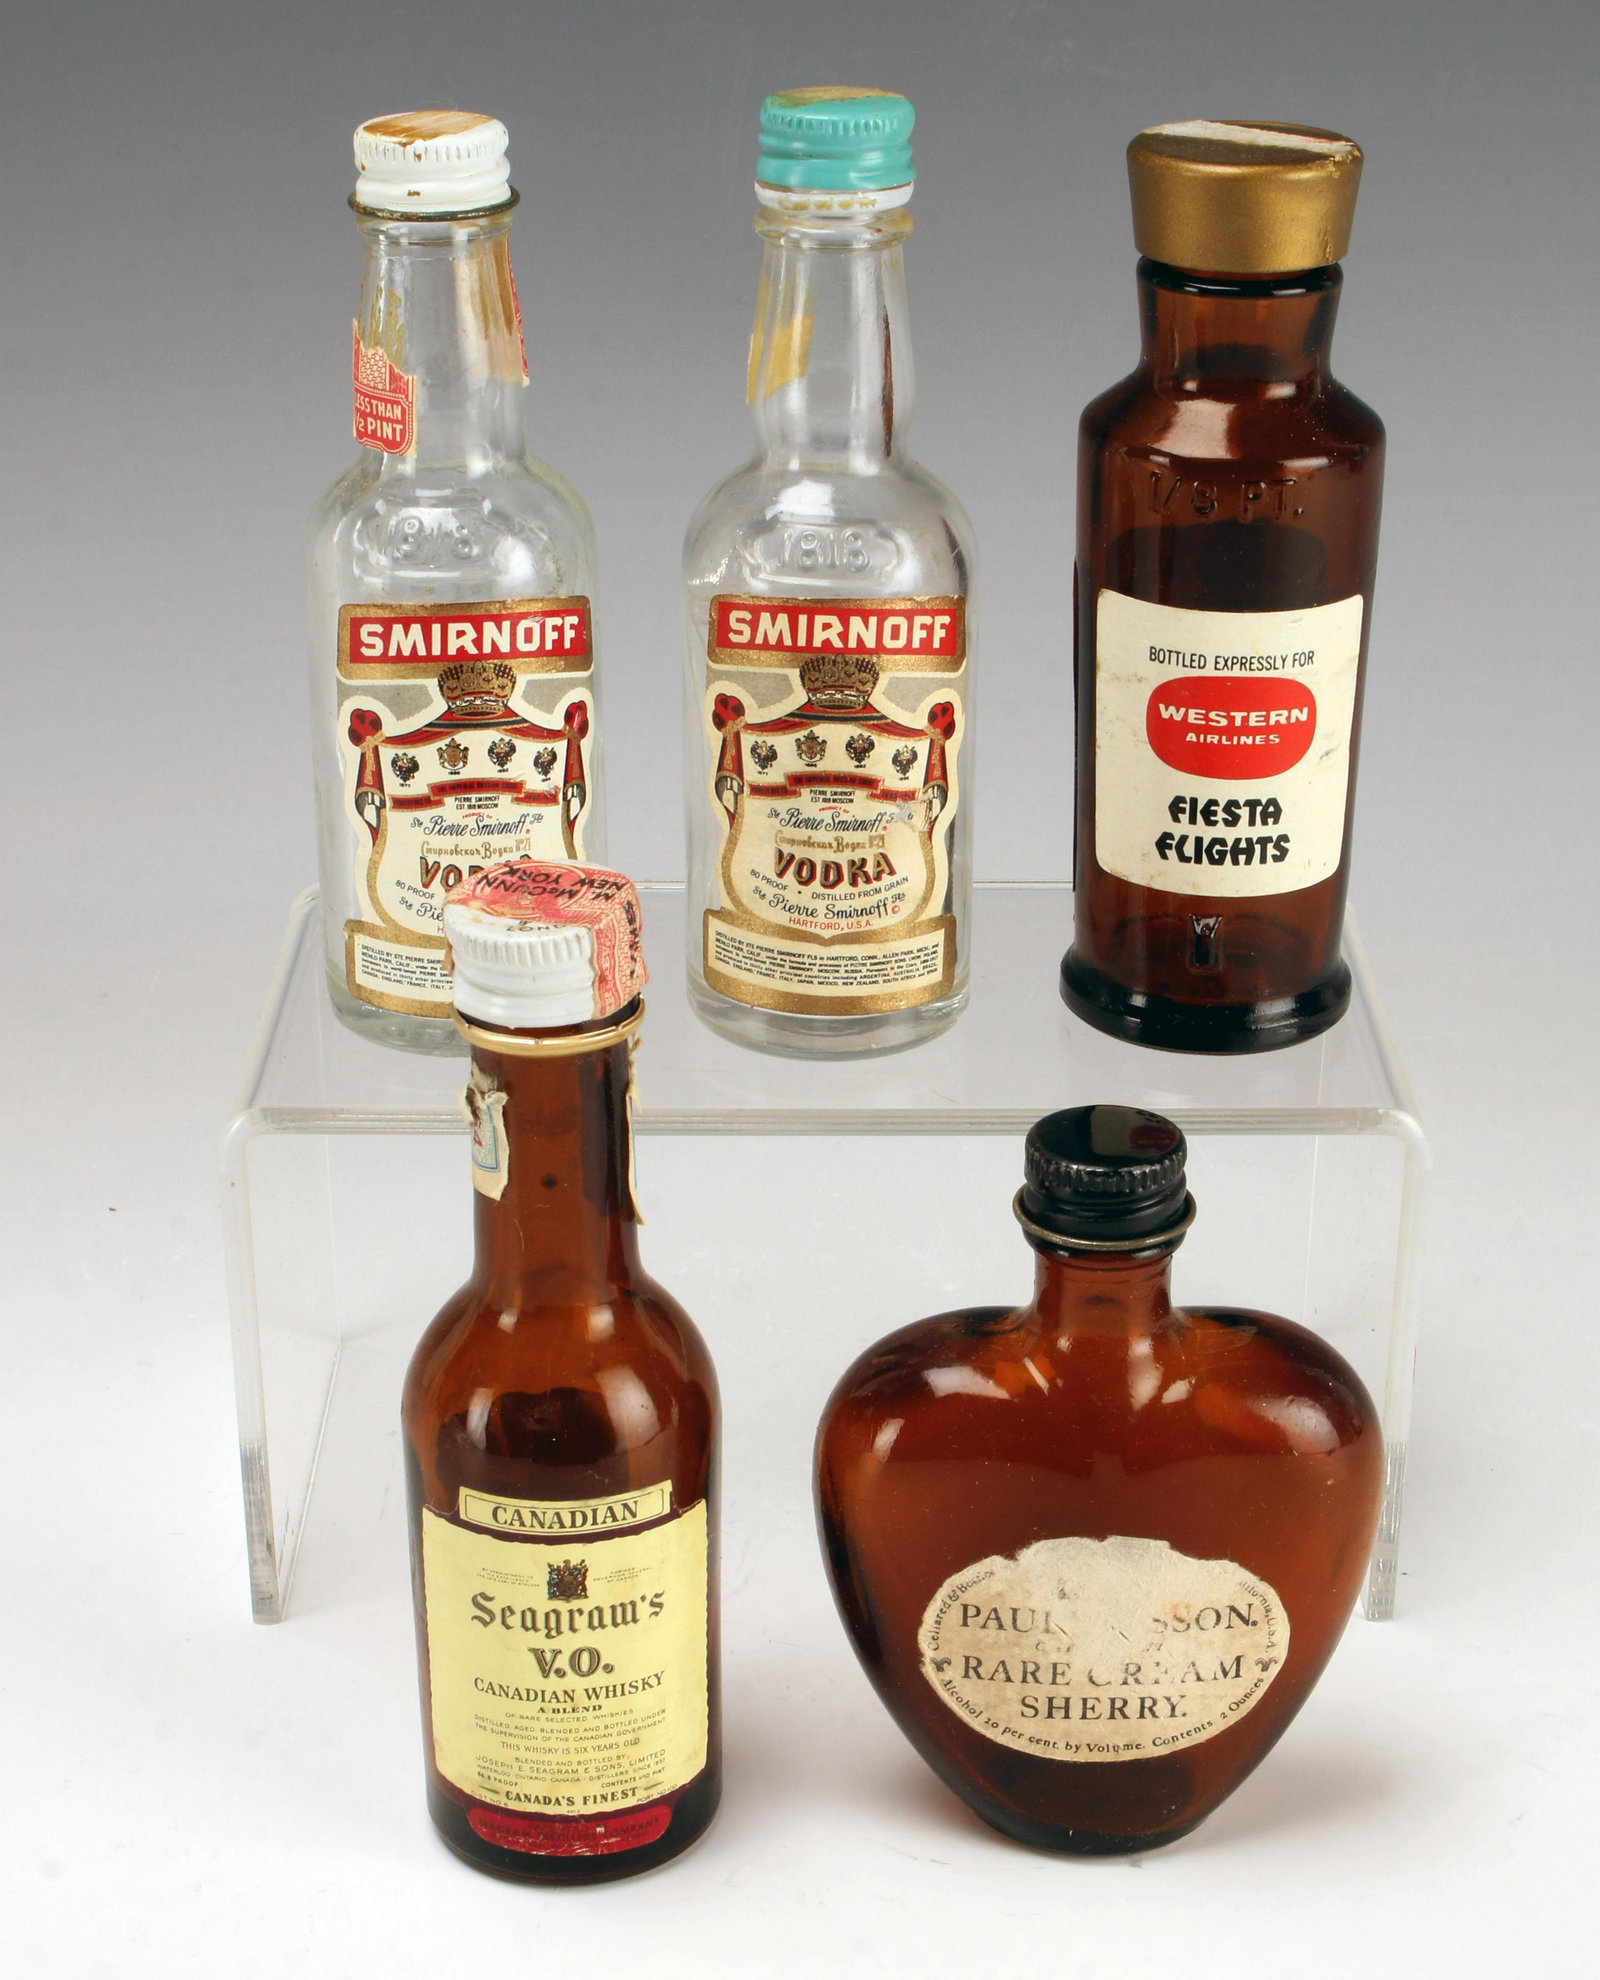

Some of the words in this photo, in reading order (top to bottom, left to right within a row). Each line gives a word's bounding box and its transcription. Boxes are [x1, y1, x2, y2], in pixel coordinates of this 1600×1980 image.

[371, 398, 402, 420] THAN
[367, 416, 404, 441] PINT
[777, 528, 872, 572] 1818
[360, 615, 579, 657] SMIRNOFF
[728, 610, 951, 649] SMIRNOFF
[1149, 645, 1207, 670] BOTTLED
[1214, 654, 1288, 672] EXPRESSLY
[1292, 650, 1315, 668] FOR
[1158, 703, 1309, 727] WESTERN
[1185, 732, 1281, 745] AIRLINES
[779, 807, 823, 830] Pierre
[824, 810, 887, 833] Smirnoff
[1167, 795, 1283, 827] FIESTA
[423, 815, 468, 837] Pierre
[469, 813, 530, 837] Smirnoff
[1155, 831, 1291, 866] FLIGHTS
[501, 864, 562, 885] YORK
[773, 846, 897, 890] VODKA
[395, 879, 406, 890] 80
[407, 885, 436, 900] PROOF
[571, 877, 627, 892] NEW
[750, 868, 761, 879] 80
[760, 874, 789, 892] PROOF
[811, 891, 856, 901] DISTILLED
[858, 886, 883, 899] FROM
[885, 876, 909, 892] GRAIN
[768, 893, 819, 918] Pierre
[824, 898, 889, 919] Smirnoff
[788, 916, 844, 931] HARTFORD,
[491, 1499, 640, 1530] CANADIAN
[470, 1590, 666, 1640] Seagram's
[928, 1599, 952, 1651] Cellared
[527, 1646, 616, 1679] V.O.
[961, 1654, 1072, 1686] RARE
[1086, 1654, 1246, 1688] CREAM
[473, 1676, 576, 1704] CANADIAN
[584, 1670, 665, 1701] WHISKY
[519, 1714, 541, 1722] RARE
[592, 1708, 634, 1720] WHISKIES
[537, 1706, 547, 1714] A
[551, 1704, 603, 1714] BLEND
[941, 1678, 983, 1719] Alcohol
[984, 1717, 999, 1729] 20
[1001, 1726, 1024, 1740] per
[1028, 1735, 1059, 1750] cent.
[1065, 1741, 1082, 1754] by
[1086, 1742, 1146, 1754] Volume.
[1151, 1719, 1214, 1747] Contents
[1219, 1711, 1228, 1720] 2
[1228, 1677, 1265, 1712] Ounces
[1020, 1694, 1188, 1720] SHERRY.
[475, 1722, 488, 1731] THE
[490, 1728, 539, 1741] SUPERVISION
[573, 1733, 613, 1743] CANADIAN
[616, 1717, 666, 1737] GOVERNMENT
[583, 1725, 601, 1733] AND
[603, 1719, 639, 1730] BOTTLED
[641, 1708, 666, 1722] UNDER
[501, 1741, 521, 1752] THIS
[523, 1745, 560, 1756] WHISKY
[562, 1747, 571, 1755] IS
[574, 1746, 589, 1755] SIX
[591, 1742, 620, 1753] YEARS
[623, 1737, 640, 1748] OLD
[476, 1754, 513, 1769] JOSEPH
[529, 1766, 579, 1775] SEAGRAM
[629, 1749, 666, 1766] LIMITED
[477, 1764, 511, 1777] WATERLOO
[514, 1773, 547, 1782] ONTARIO
[589, 1770, 629, 1781] DISTILLERS
[633, 1764, 651, 1773] SINCE
[515, 1757, 553, 1766] BLENDED
[576, 1756, 613, 1766] BOTTLED
[494, 1776, 518, 1786] PROOF
[601, 1776, 637, 1788] CONTENTS
[652, 1767, 666, 1776] PINT
[505, 1790, 576, 1807] CANADA'S
[582, 1786, 638, 1806] FINEST
